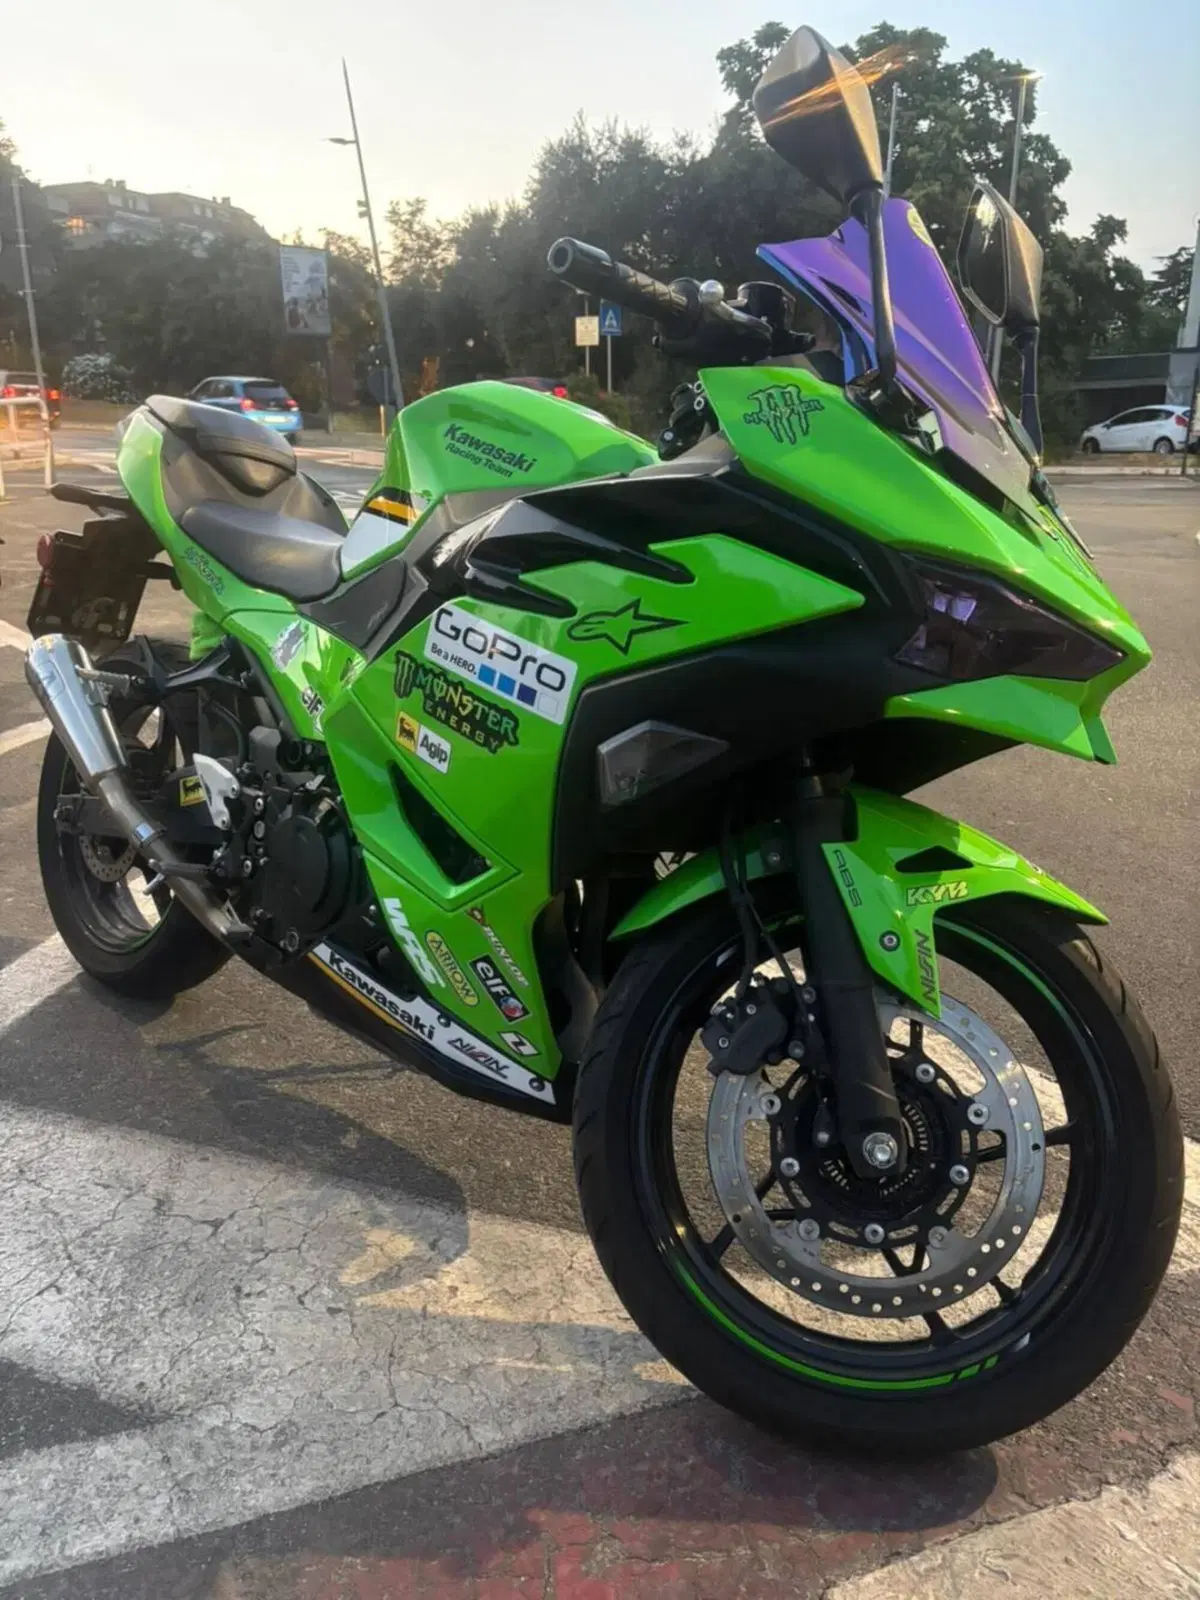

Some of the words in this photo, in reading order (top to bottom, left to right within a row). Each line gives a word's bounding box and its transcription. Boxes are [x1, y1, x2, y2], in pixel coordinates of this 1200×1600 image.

[443, 423, 537, 473] Kawasaki
[445, 442, 482, 465] Racing
[484, 458, 513, 478] Team
[431, 643, 441, 654] Be
[442, 651, 449, 660] a
[450, 654, 477, 676] HERO.
[415, 673, 518, 744] MONSTER
[425, 701, 502, 752] ENERGY
[419, 733, 448, 764] Agip
[833, 849, 862, 908] ABS
[906, 881, 969, 907] KYB
[428, 939, 476, 1001] ARROW
[484, 926, 529, 987] DUNLOP
[328, 949, 437, 1041] Kawasaki
[476, 961, 508, 1003] elf
